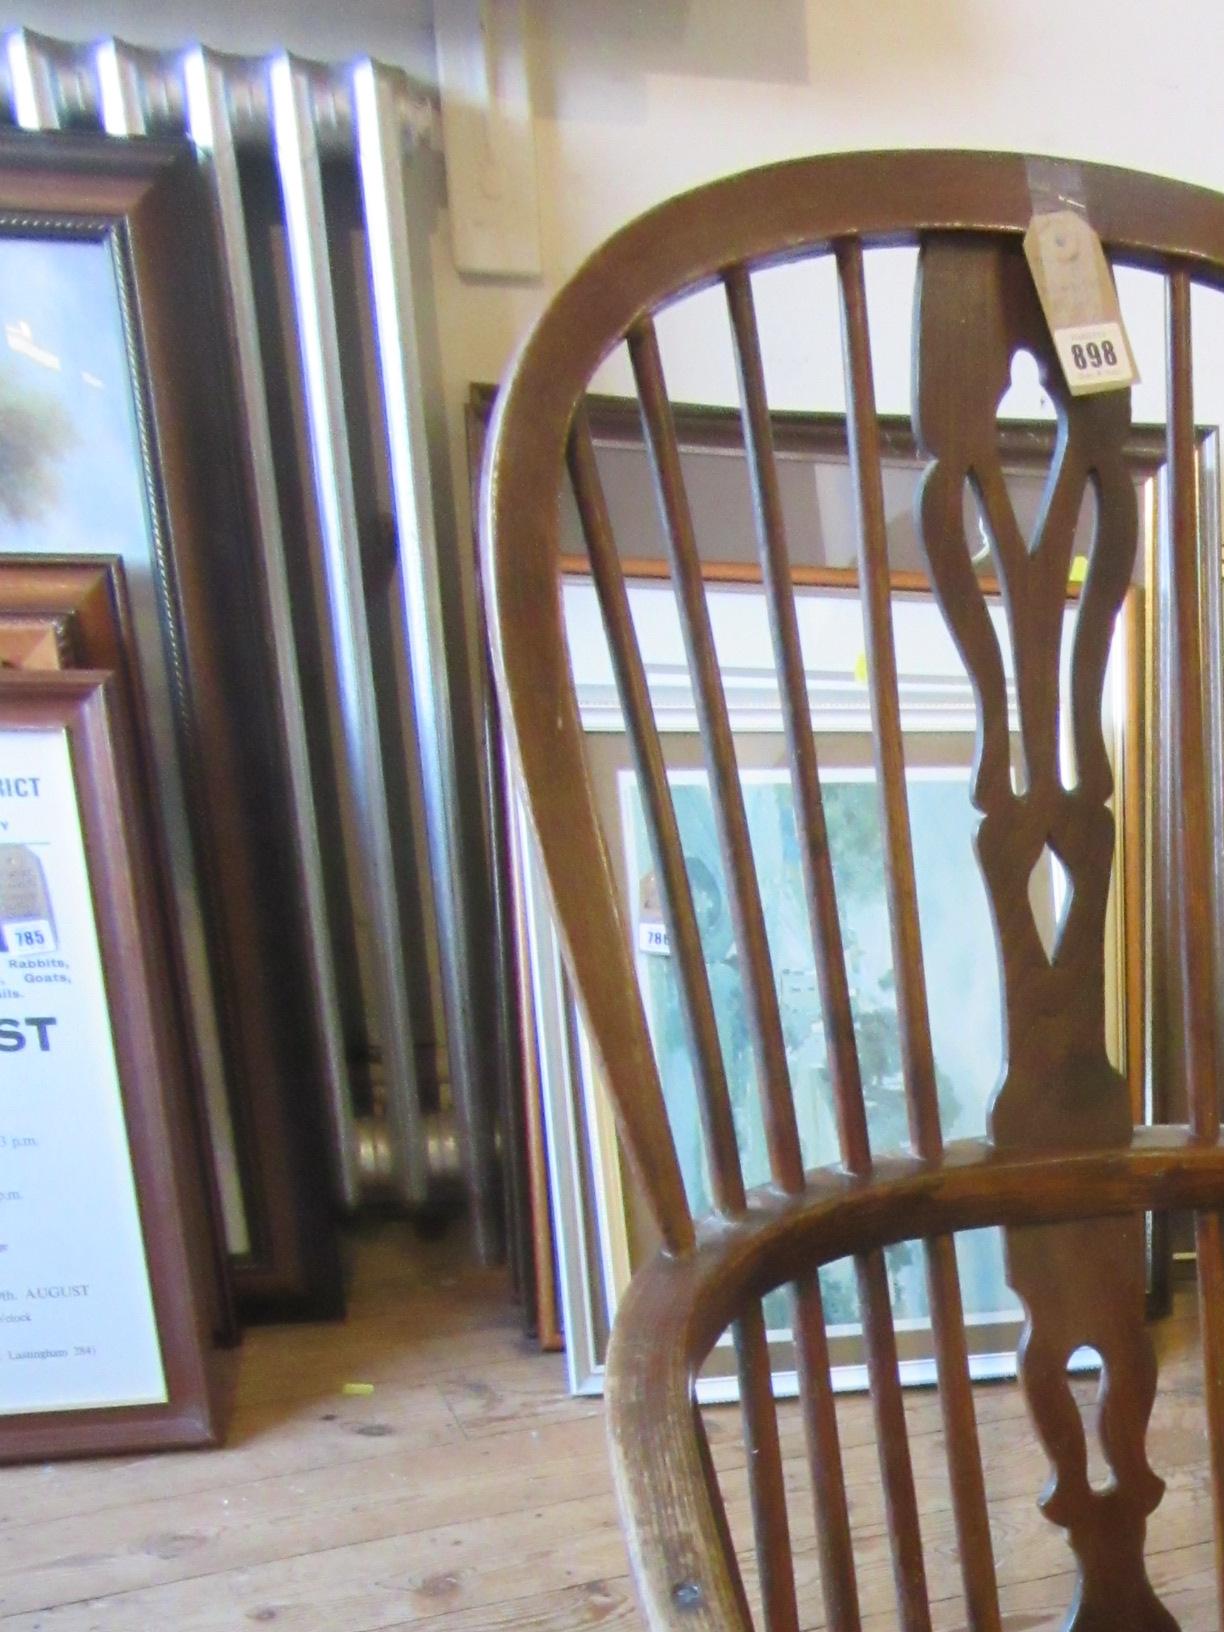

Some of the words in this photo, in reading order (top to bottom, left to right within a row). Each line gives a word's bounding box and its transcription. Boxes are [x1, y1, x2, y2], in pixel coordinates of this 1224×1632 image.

[1071, 340, 1118, 370] 898
[14, 929, 46, 947] 785
[8, 958, 70, 970] Rabbits,
[23, 973, 72, 984] Goats,
[26, 1284, 90, 1299] AUGUST
